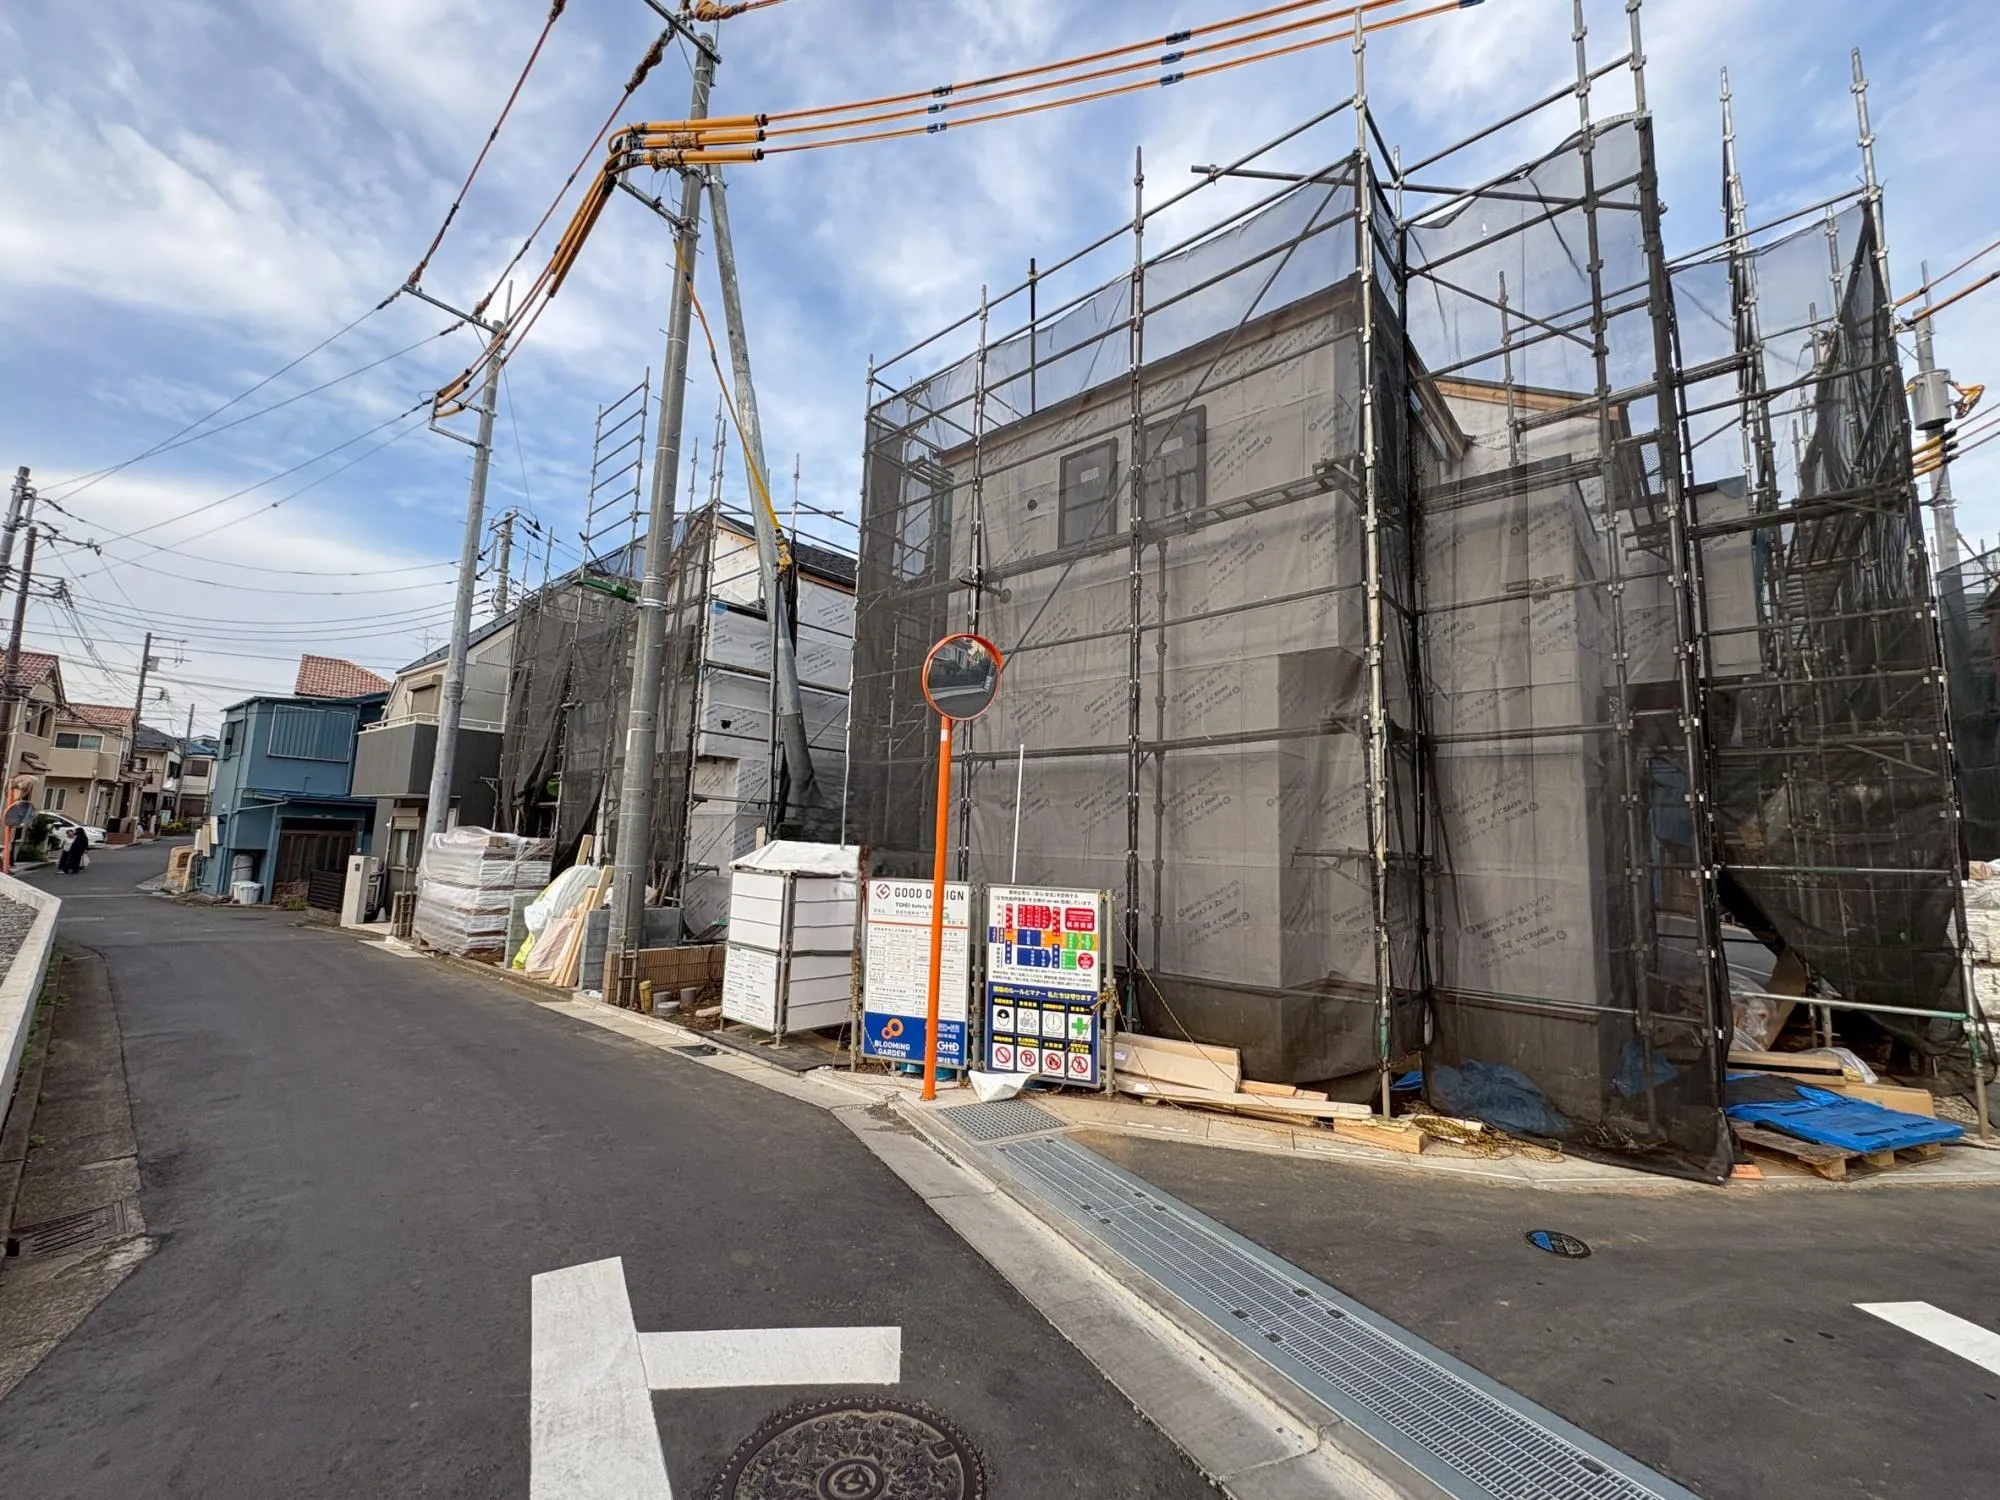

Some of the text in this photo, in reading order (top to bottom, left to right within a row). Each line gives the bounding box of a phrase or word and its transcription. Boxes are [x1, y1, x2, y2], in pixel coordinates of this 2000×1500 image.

[894, 887, 964, 901] GOOD DIGN
[874, 1039, 911, 1051] BLOOMING
[877, 1048, 906, 1058] GARDEN
